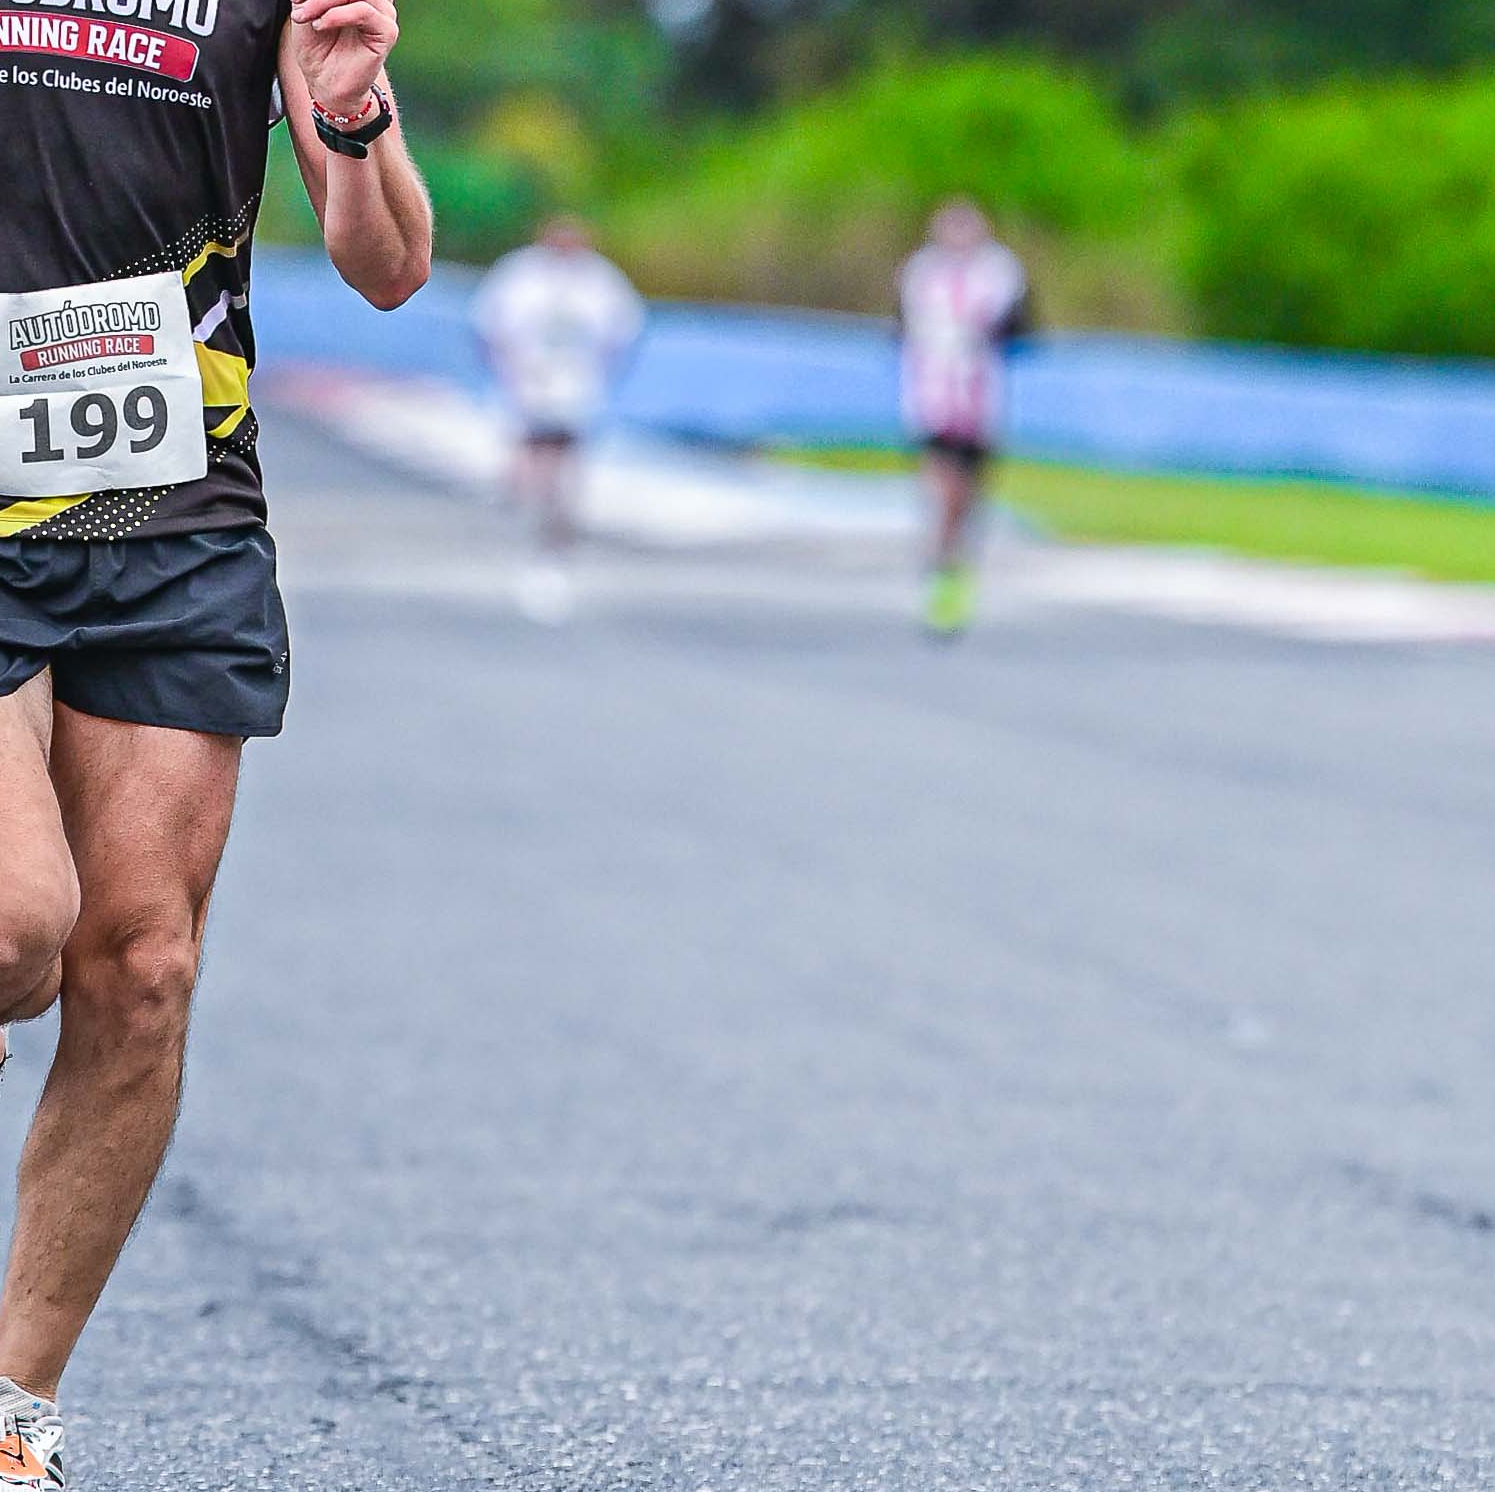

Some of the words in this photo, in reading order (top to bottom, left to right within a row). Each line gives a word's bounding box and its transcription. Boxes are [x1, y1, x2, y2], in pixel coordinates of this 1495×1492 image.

[87, 23, 167, 69] RACE
[12, 65, 38, 86] los
[42, 68, 101, 95] Clubes
[105, 76, 133, 97] del
[137, 79, 212, 109] Noroeste
[9, 300, 161, 350] AUTÓDROMO
[9, 374, 20, 384] La
[22, 371, 57, 383] Carrera
[58, 369, 71, 380] de
[72, 368, 86, 378] los
[87, 364, 116, 376] Clubes
[117, 361, 131, 372] del
[132, 357, 168, 370] Noroeste
[37, 338, 102, 367] RUNNING
[105, 337, 141, 354] RACE
[19, 385, 168, 464] 199
